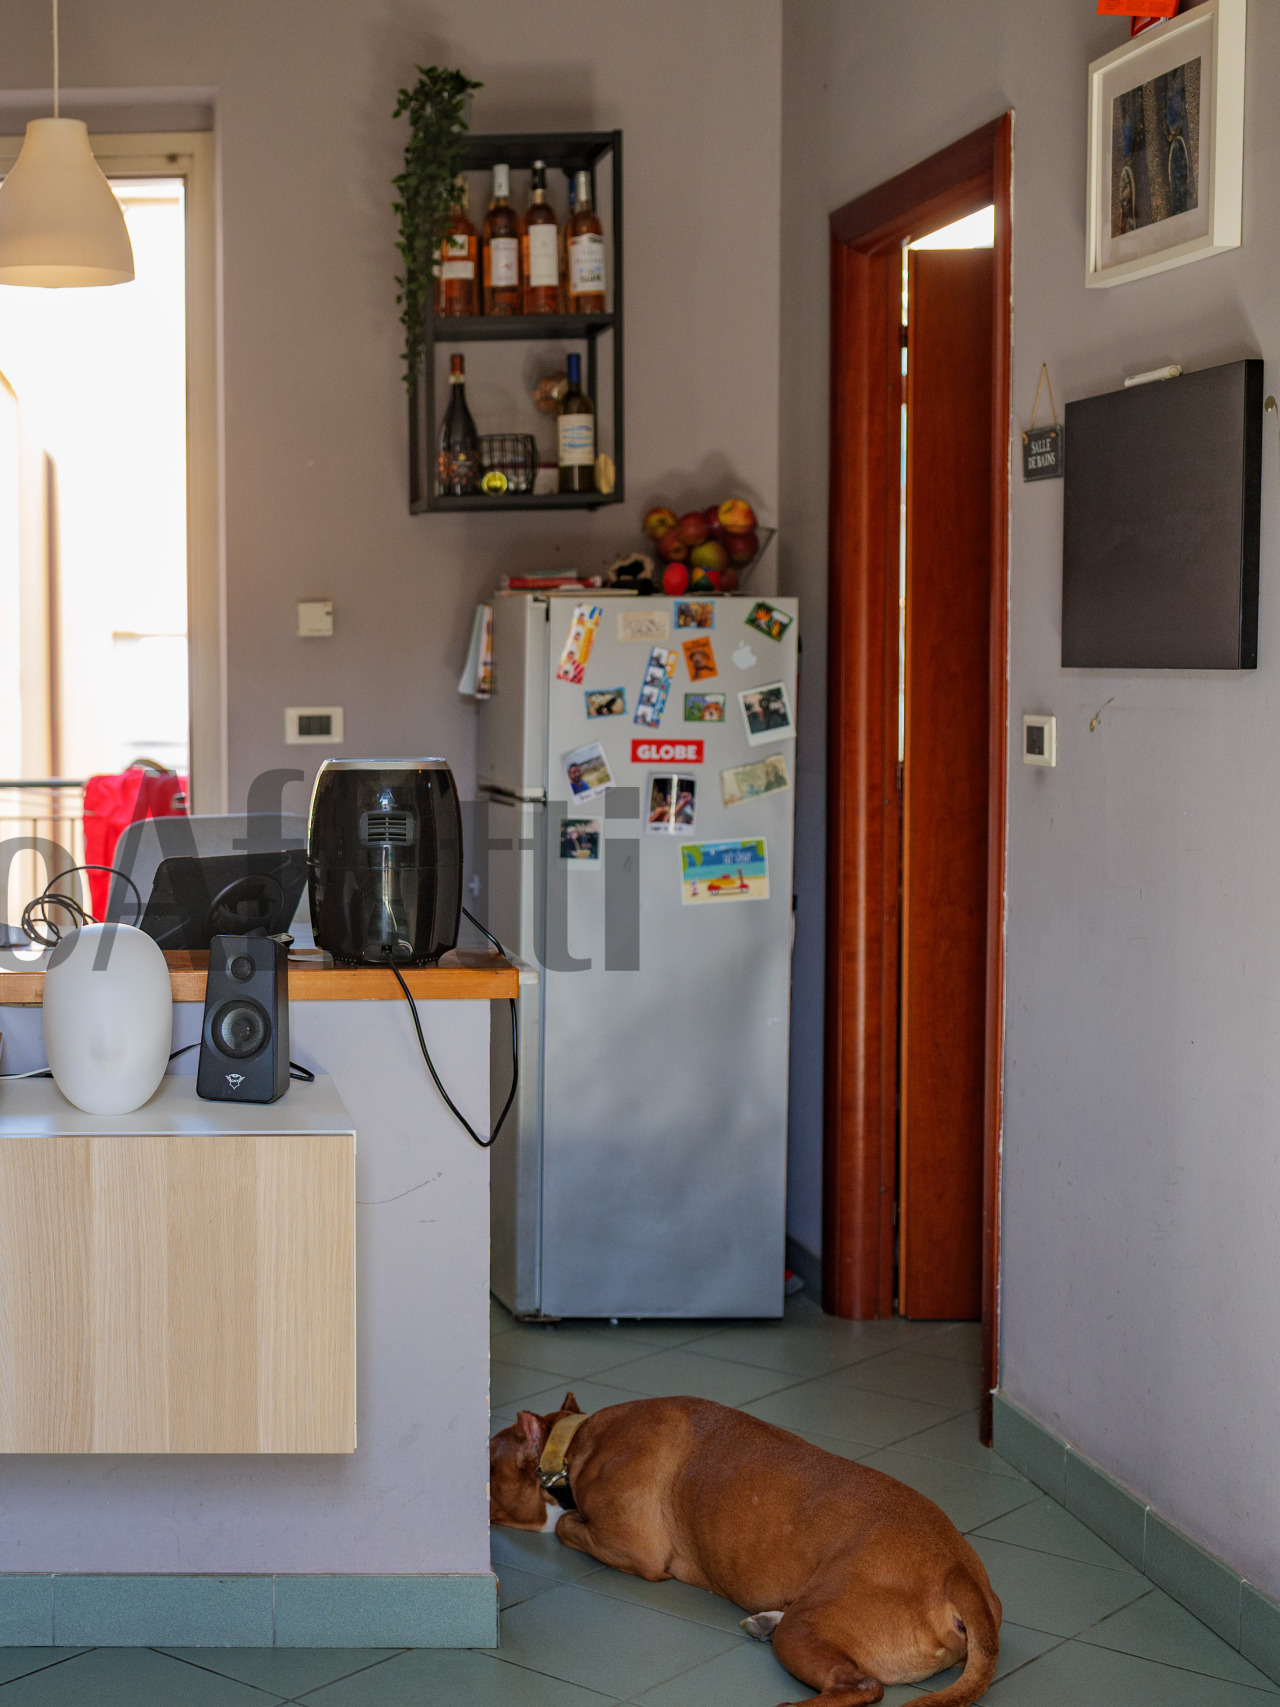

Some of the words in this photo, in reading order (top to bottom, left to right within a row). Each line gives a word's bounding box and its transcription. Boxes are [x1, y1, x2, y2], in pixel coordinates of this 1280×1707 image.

[1031, 438, 1052, 455] SALLE
[1027, 456, 1037, 470] DE
[1037, 452, 1056, 468] BAINS
[637, 744, 698, 760] GLOBE
